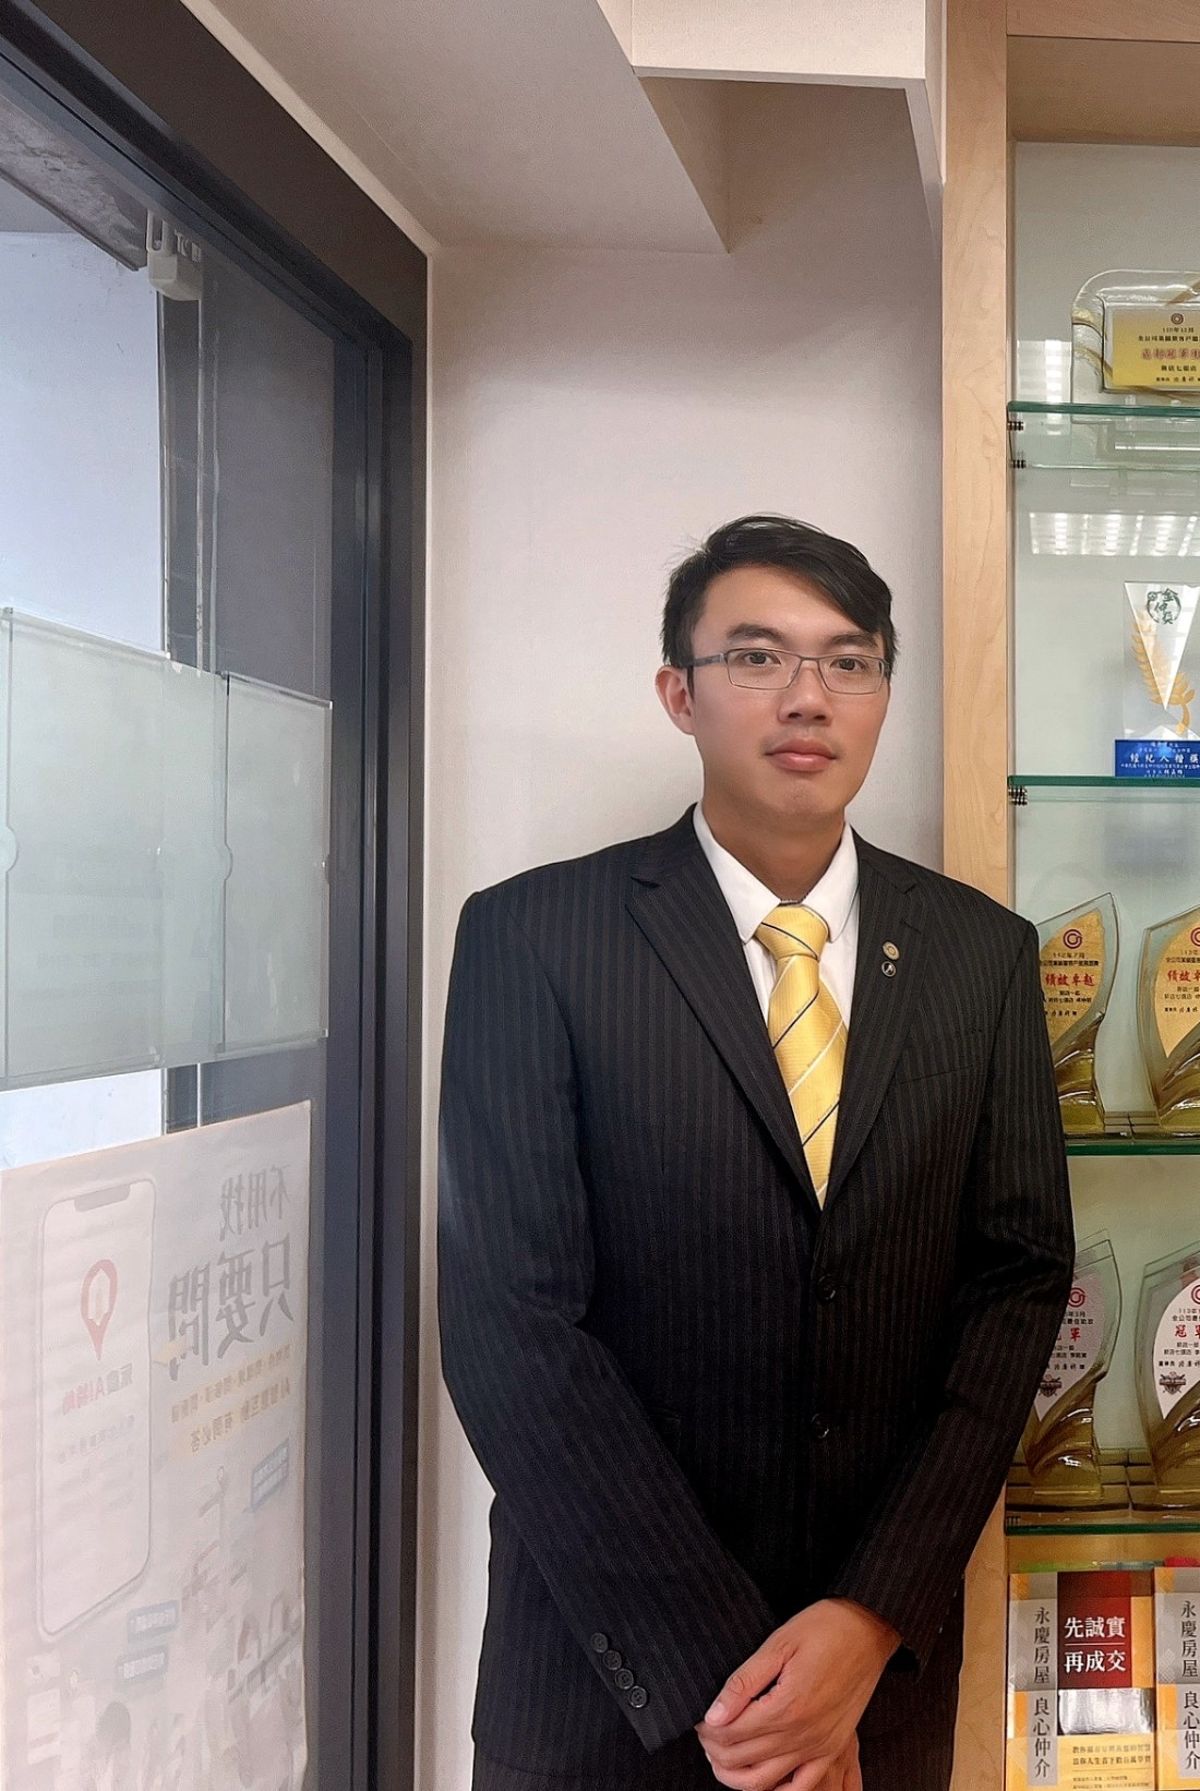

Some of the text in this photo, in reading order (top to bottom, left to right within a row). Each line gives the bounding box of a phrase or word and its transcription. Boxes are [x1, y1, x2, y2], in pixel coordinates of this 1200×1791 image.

[1045, 973, 1095, 987] 績效卓越
[1064, 1617, 1126, 1639] 先誠實
[1064, 1651, 1126, 1673] 再成交
[1032, 1606, 1050, 1778] 永慶房屋 良心仲介
[1180, 1600, 1200, 1770] 永慶房屋 良心仲介
